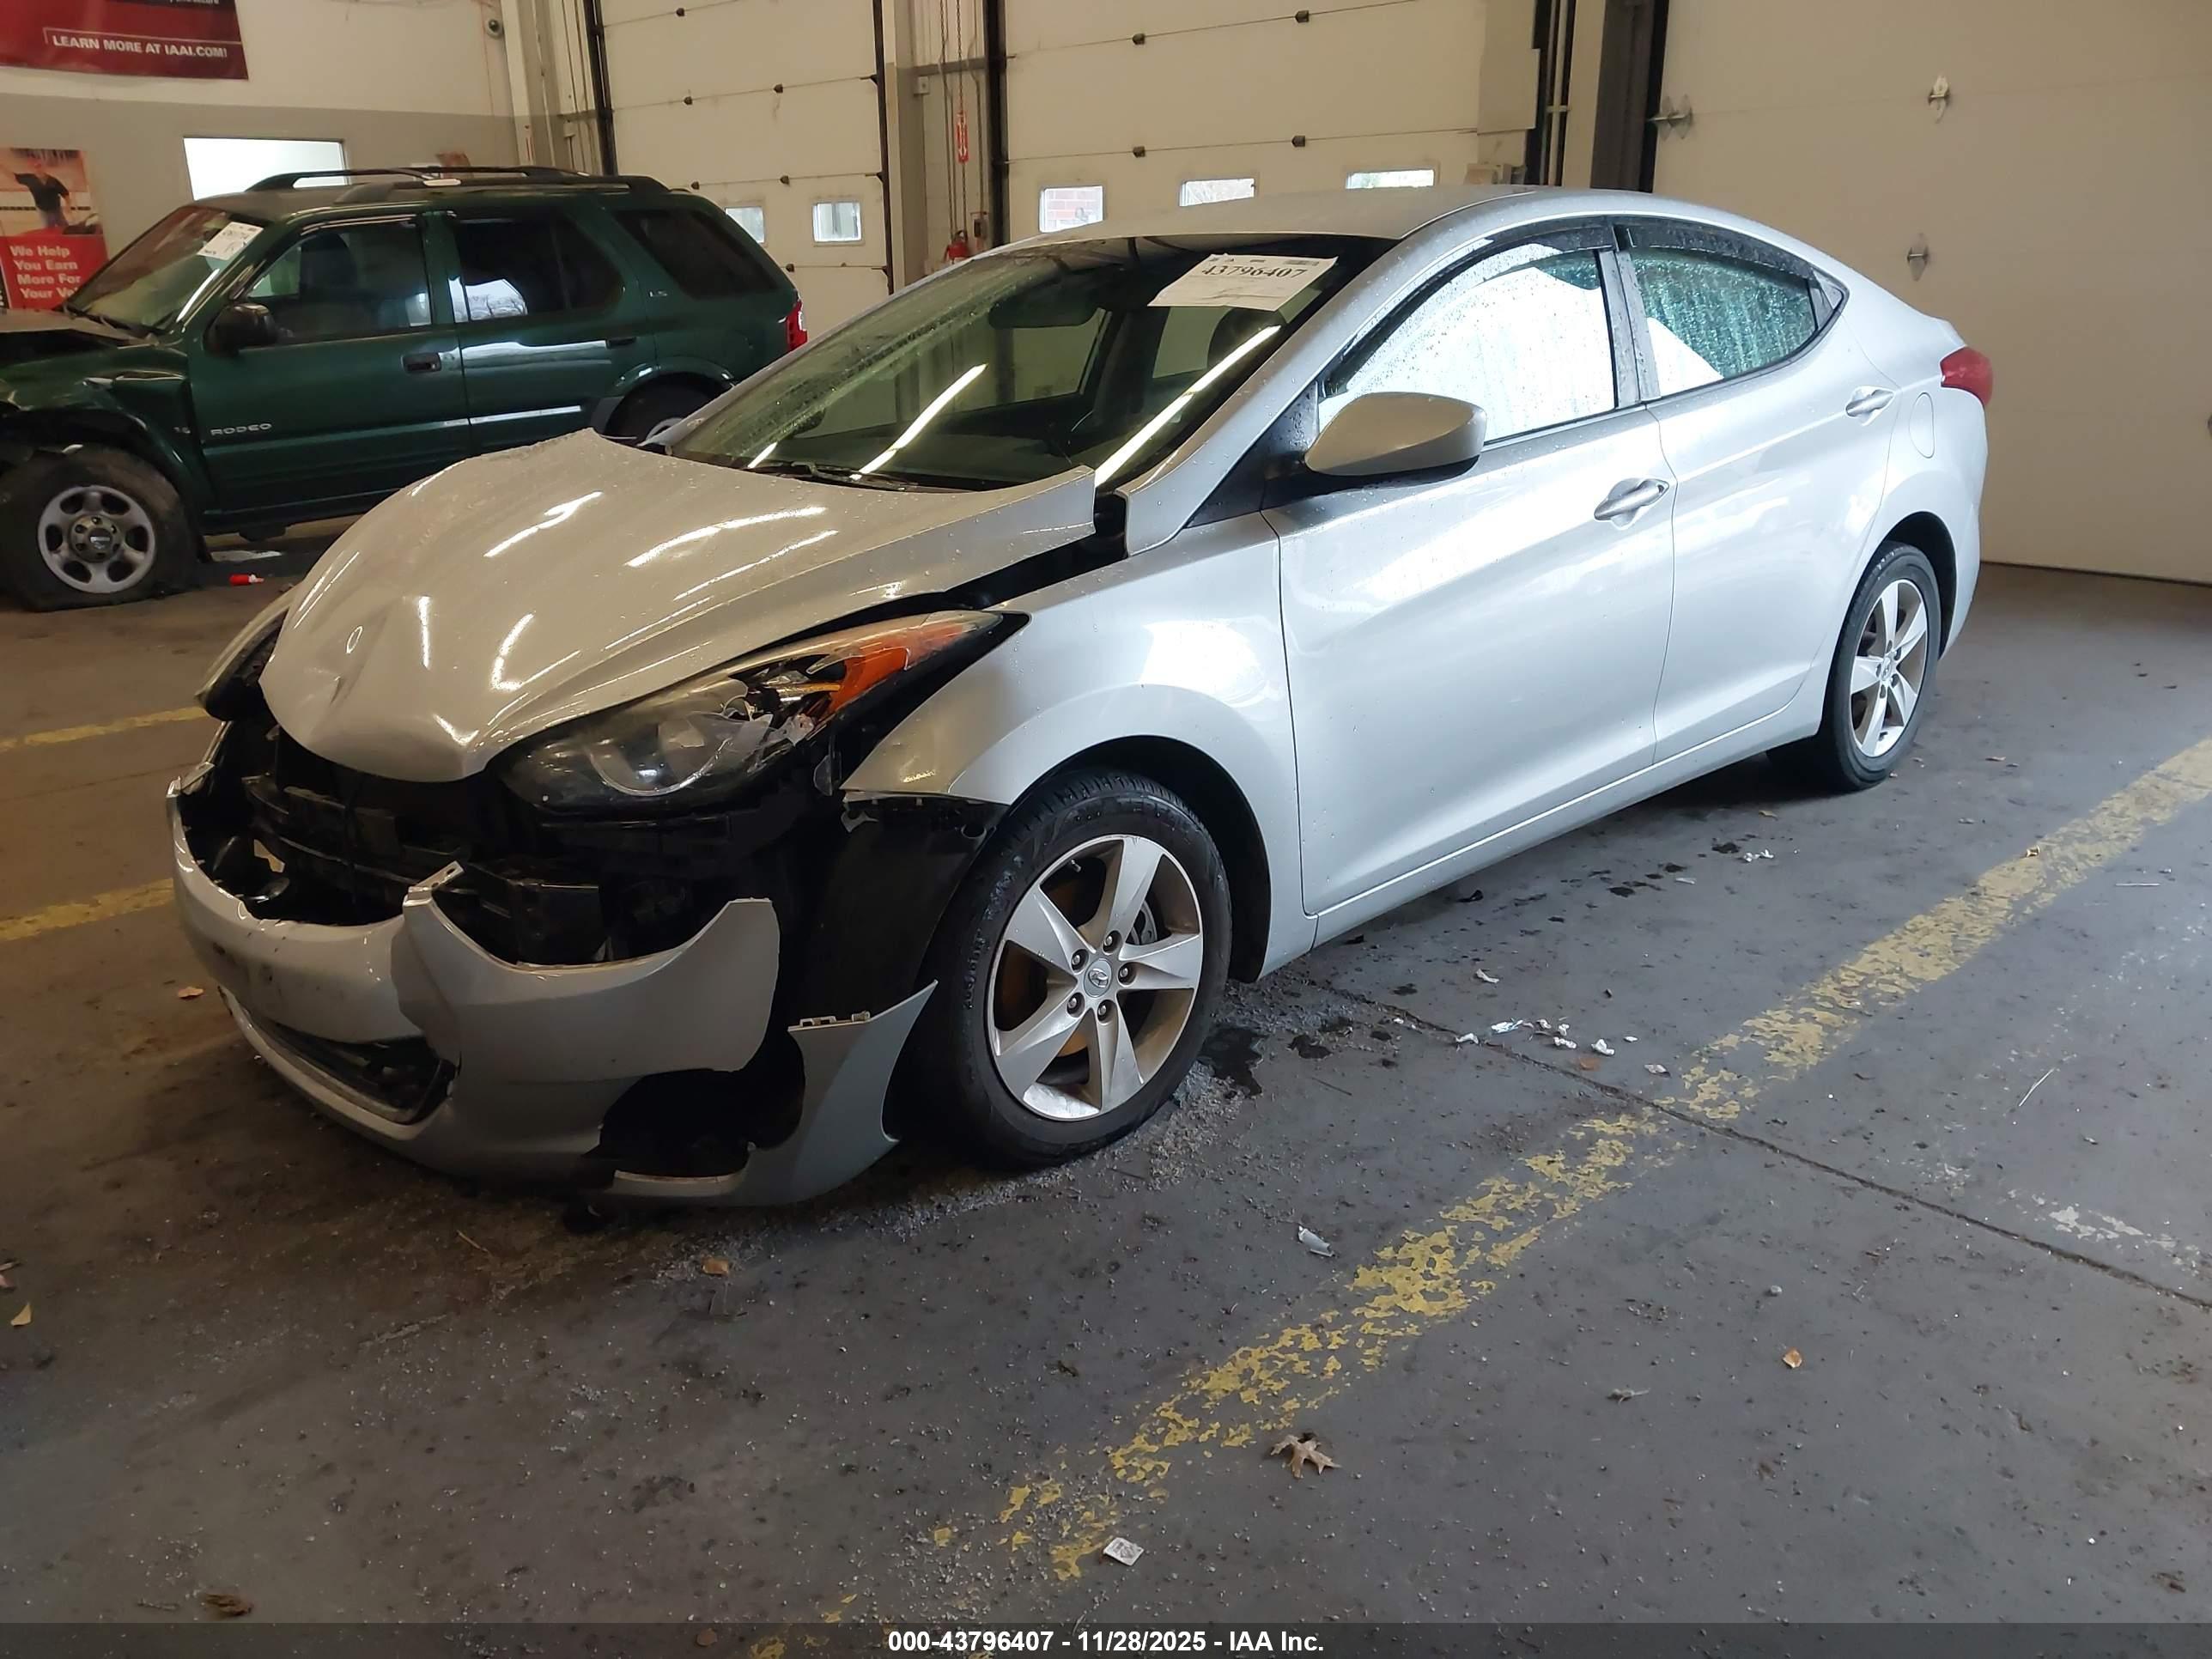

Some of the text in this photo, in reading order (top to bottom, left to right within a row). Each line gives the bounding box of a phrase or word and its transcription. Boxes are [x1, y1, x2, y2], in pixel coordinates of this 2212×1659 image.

[52, 35, 228, 58] LEARN MORE AT IAAI.COM!
[9, 246, 70, 258] We Help
[13, 259, 78, 270] You Earn
[1202, 264, 1309, 278] 43796407
[16, 272, 81, 285] More For
[20, 288, 53, 299] Your
[210, 422, 272, 436] RODEO
